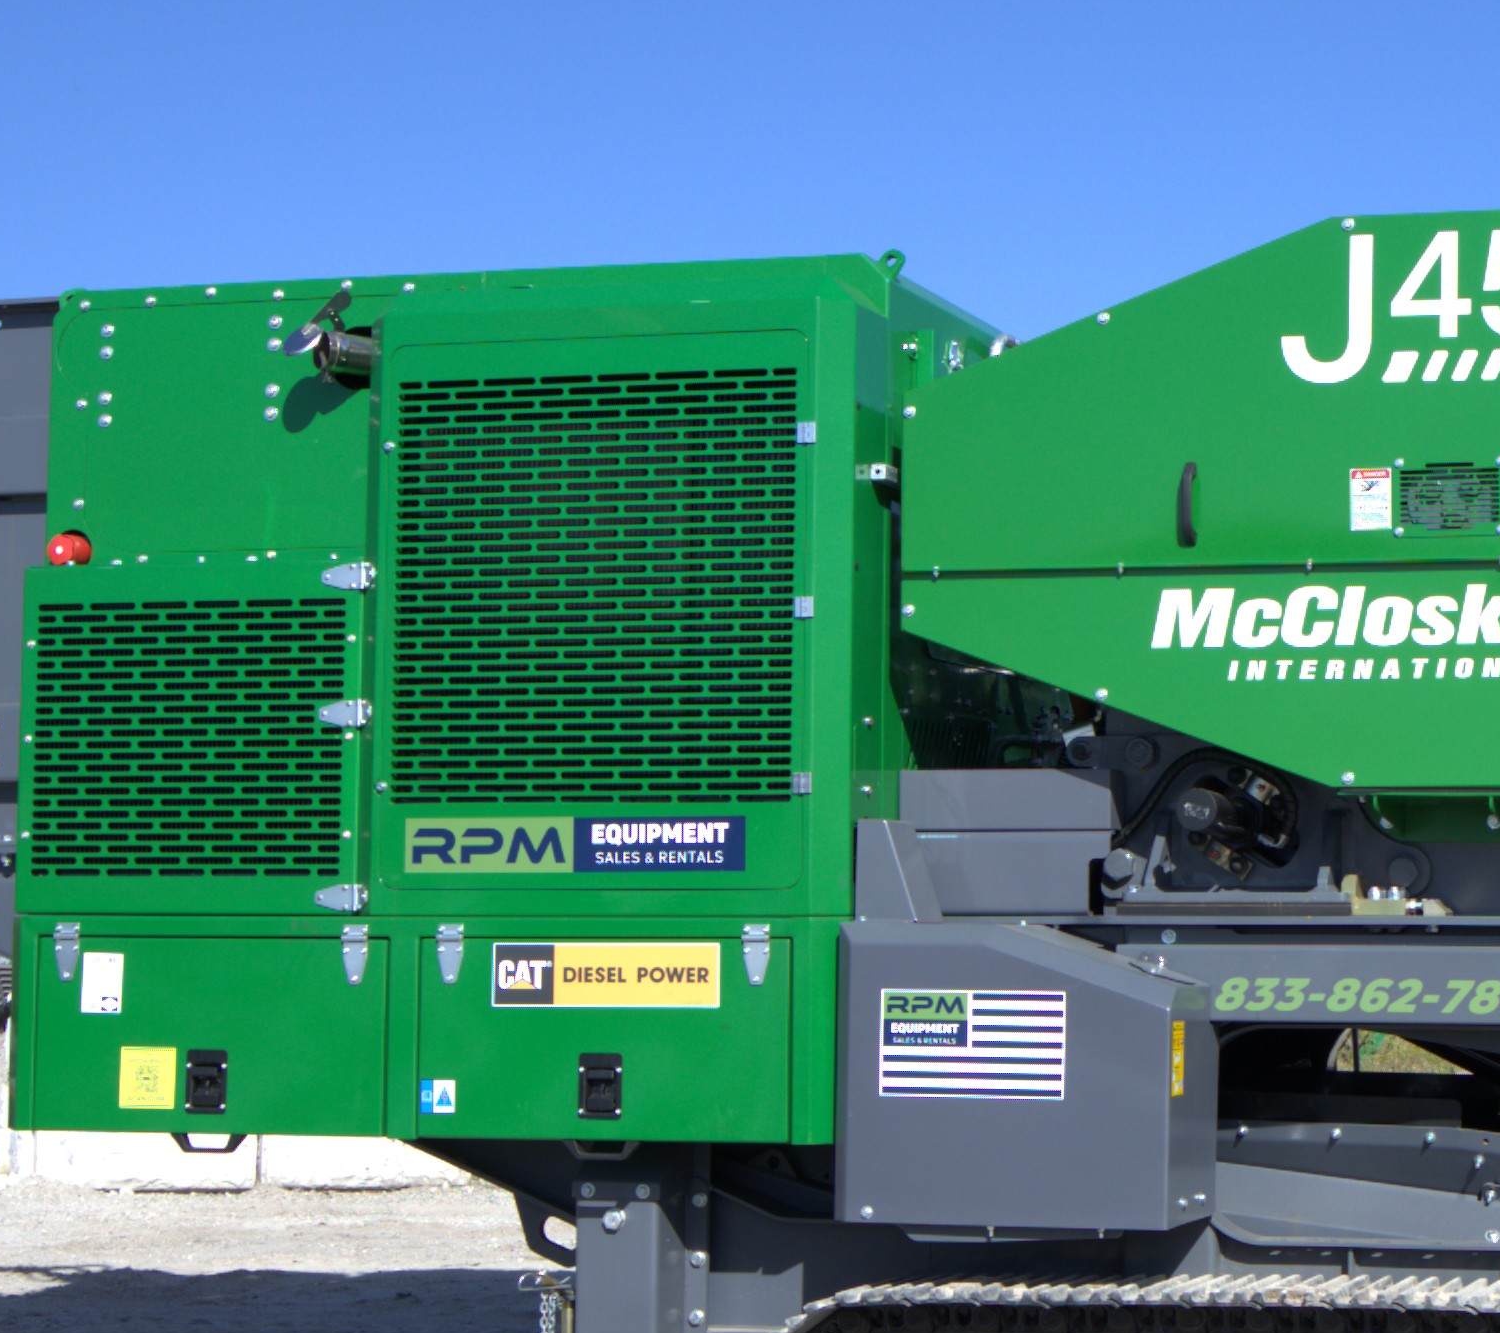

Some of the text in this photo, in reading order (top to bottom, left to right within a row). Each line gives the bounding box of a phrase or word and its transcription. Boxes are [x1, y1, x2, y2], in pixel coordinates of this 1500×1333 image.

[590, 822, 730, 846] EQUIPMENT
[412, 827, 566, 864] RPM
[595, 850, 724, 864] SALES & RENTALS
[498, 960, 709, 990] CAT DIESEL POWER
[887, 996, 964, 1014] RPM
[890, 1022, 960, 1034] EQUIPMENT
[893, 1036, 916, 1044] SALES
[924, 1037, 956, 1045] RENTALS
